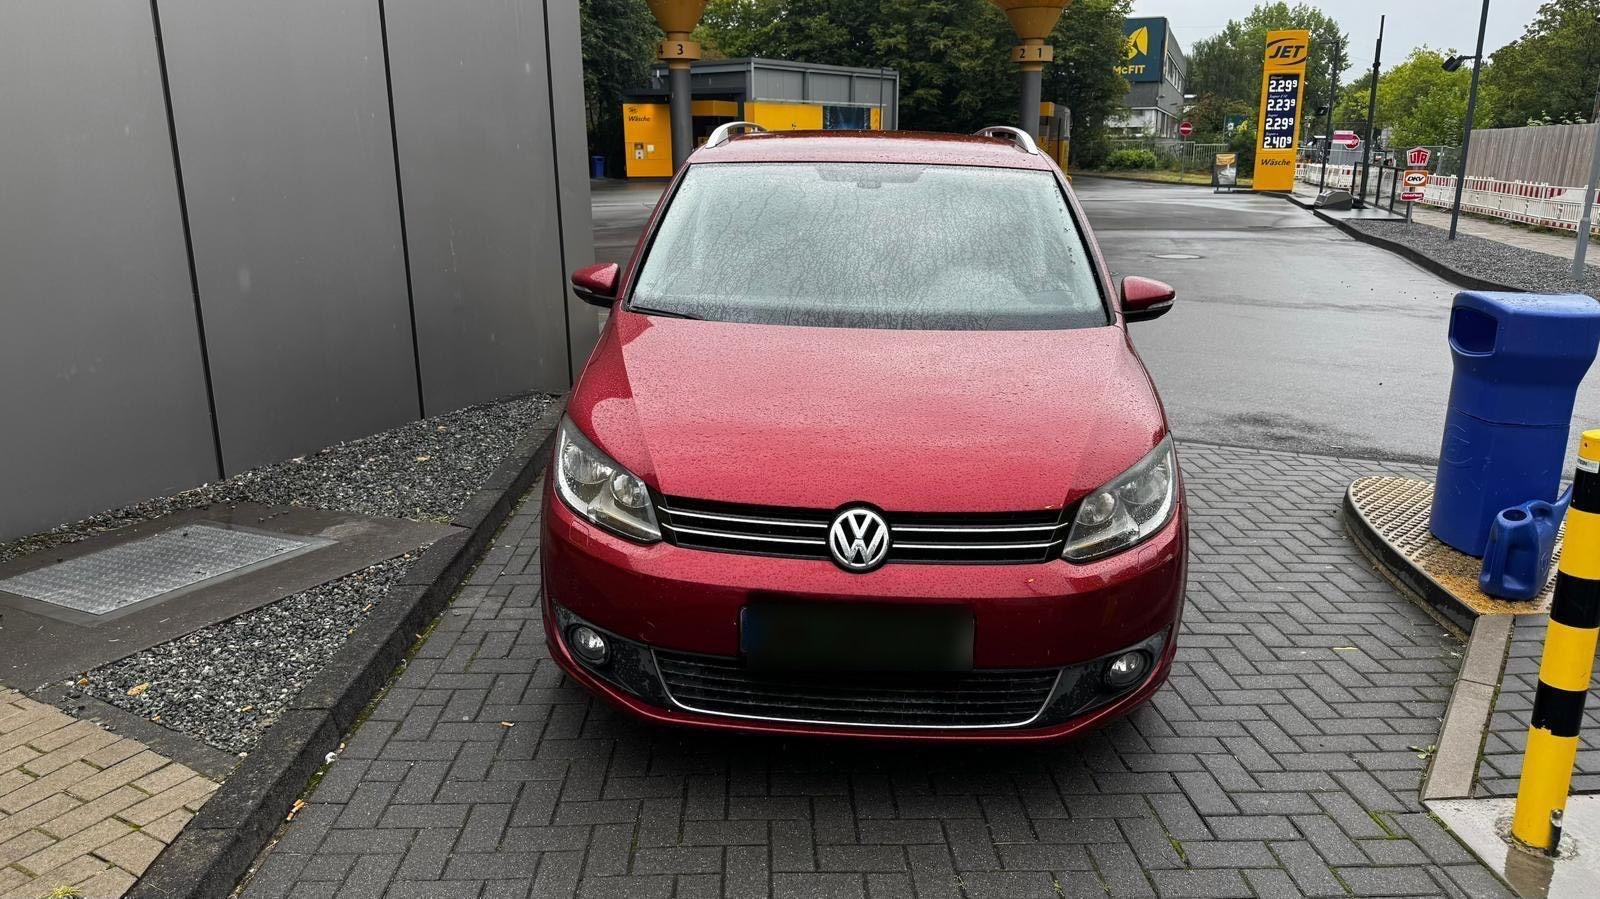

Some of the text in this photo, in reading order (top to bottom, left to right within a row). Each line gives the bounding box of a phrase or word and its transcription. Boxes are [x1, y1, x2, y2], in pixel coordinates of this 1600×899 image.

[676, 44, 684, 55] 3
[1020, 48, 1043, 59] 2 1
[1269, 45, 1305, 59] JET
[1112, 64, 1146, 75] McFIT
[1269, 79, 1298, 93] 2.299
[1267, 98, 1296, 111] 2.239
[1265, 117, 1294, 130] 2.299
[1263, 136, 1292, 149] 2.409
